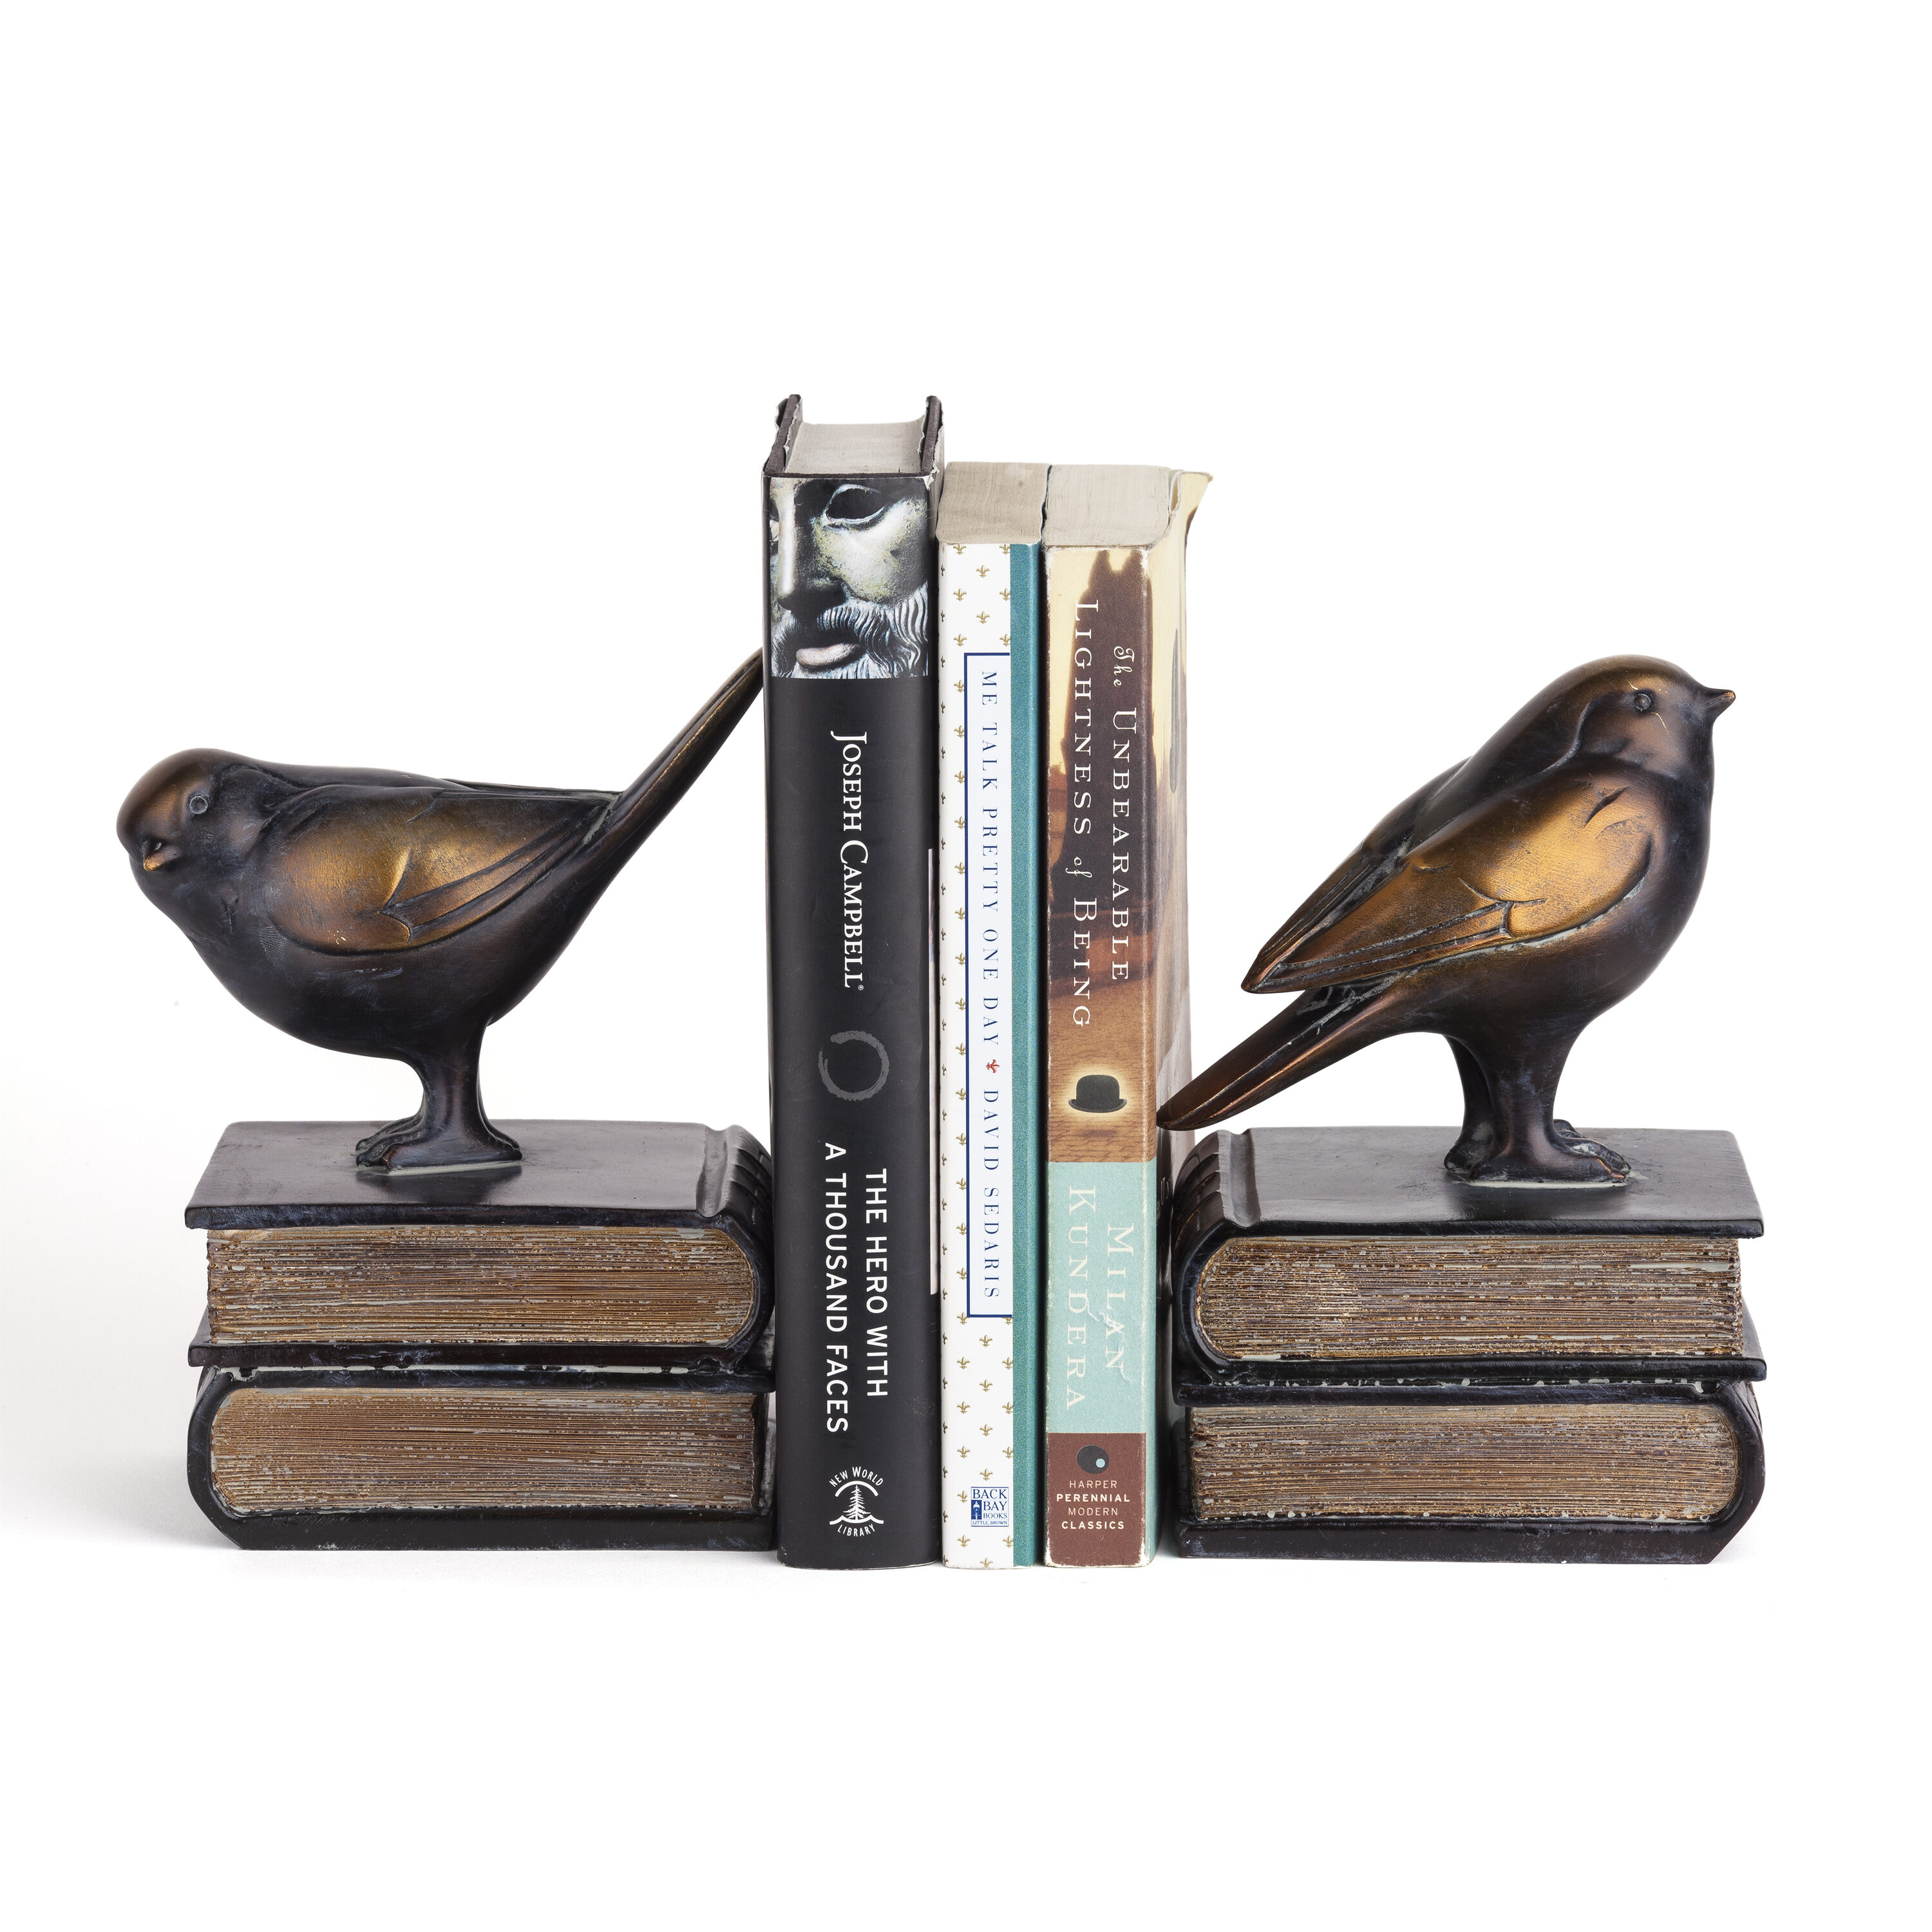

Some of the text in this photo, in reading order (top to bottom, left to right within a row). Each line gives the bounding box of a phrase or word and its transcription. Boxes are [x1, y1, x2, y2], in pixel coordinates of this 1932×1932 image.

[830, 730, 867, 831] JOSEPH
[1065, 600, 1099, 1027] LIGHTNESS of BEING
[1112, 646, 1137, 980] The UNBEARABLE
[981, 672, 1000, 1298] ME TALK PRETTY ONE DAY DAVID SEDARIS
[824, 1142, 849, 1432] A THOUSAND FACES
[865, 1168, 888, 1396] THE HERO WITH
[1066, 1185, 1096, 1410] KUNDERA
[1106, 1222, 1133, 1370] MILAN
[829, 1466, 884, 1487] NEW WORLD
[972, 1489, 1007, 1499] BACK
[983, 1501, 1007, 1511] BAY
[1056, 1493, 1130, 1502] PERENNIAL
[1069, 1480, 1117, 1489] HARPER
[837, 1524, 875, 1537] LIBRARY
[1061, 1520, 1124, 1530] CLASSICS
[1068, 1507, 1118, 1516] MODERN
